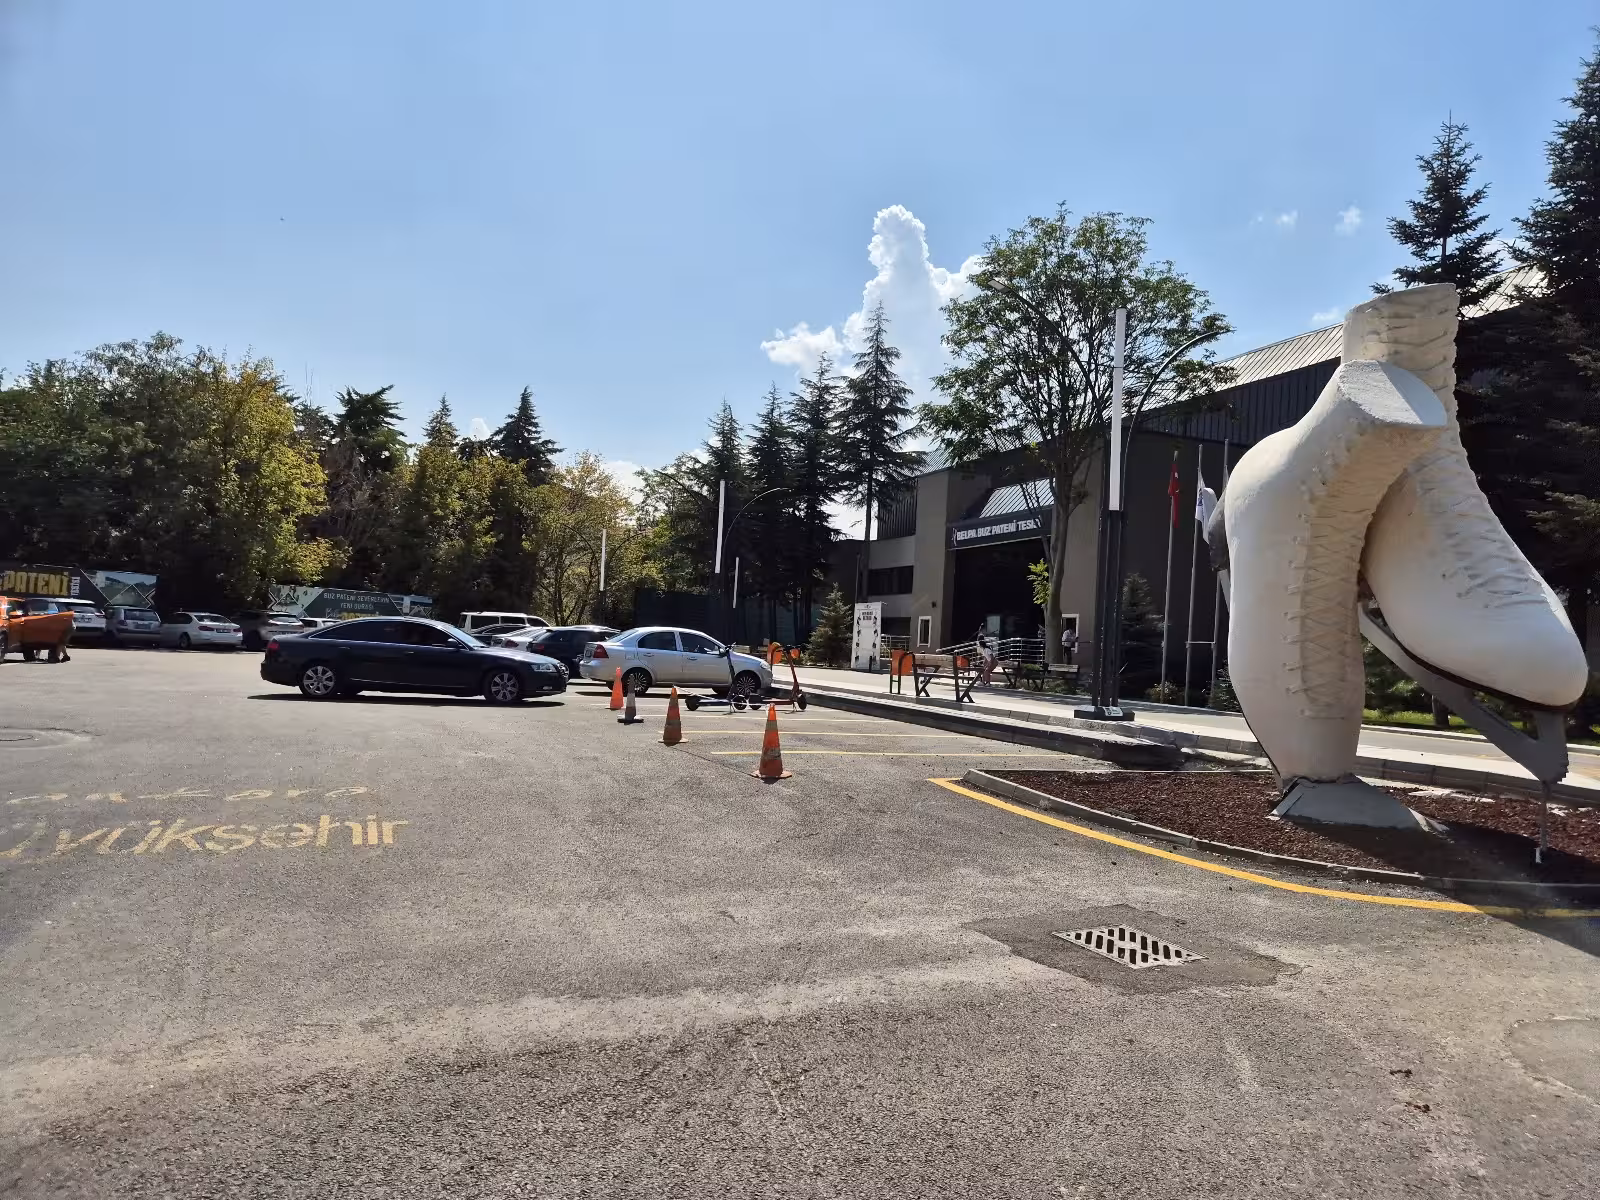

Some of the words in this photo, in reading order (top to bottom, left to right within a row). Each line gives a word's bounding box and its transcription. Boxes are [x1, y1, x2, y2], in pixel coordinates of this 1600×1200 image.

[957, 528, 977, 541] BELPA
[977, 526, 992, 537] BUZ
[323, 592, 336, 600] BUZ
